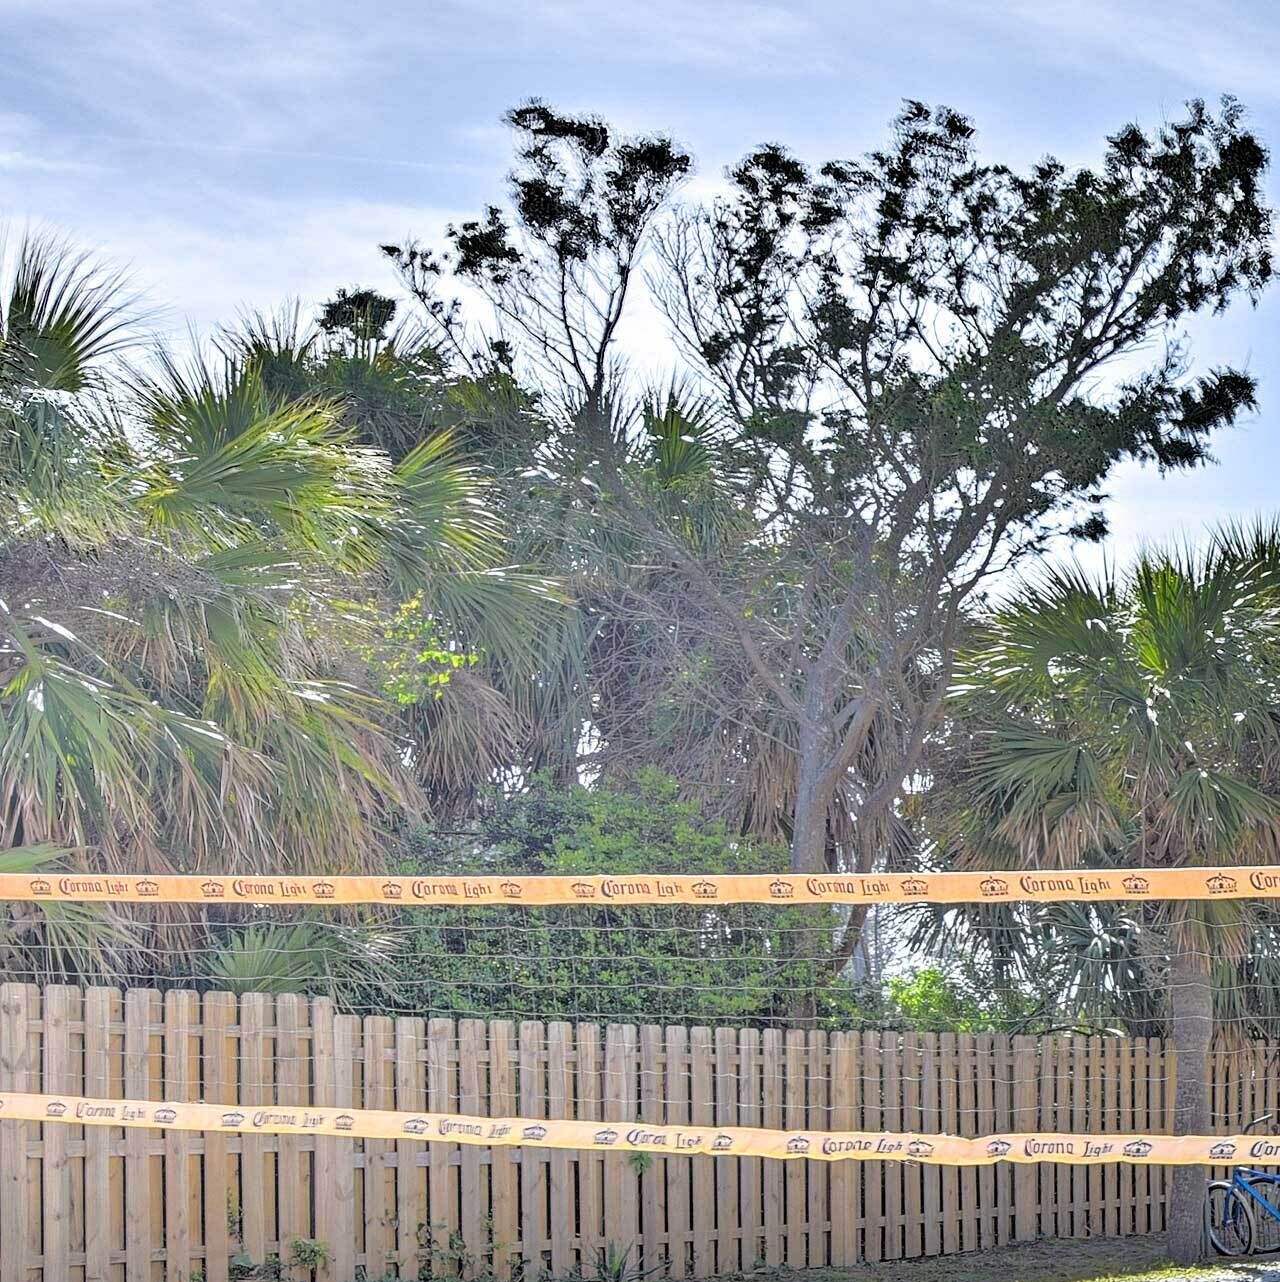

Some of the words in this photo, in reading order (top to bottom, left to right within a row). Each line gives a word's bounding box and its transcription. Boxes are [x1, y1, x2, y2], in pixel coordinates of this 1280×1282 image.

[806, 878, 854, 898] Corona
[861, 879, 890, 896] Light
[1019, 876, 1075, 896] Corona
[1079, 877, 1112, 895] Light
[1024, 1138, 1074, 1158] Corona
